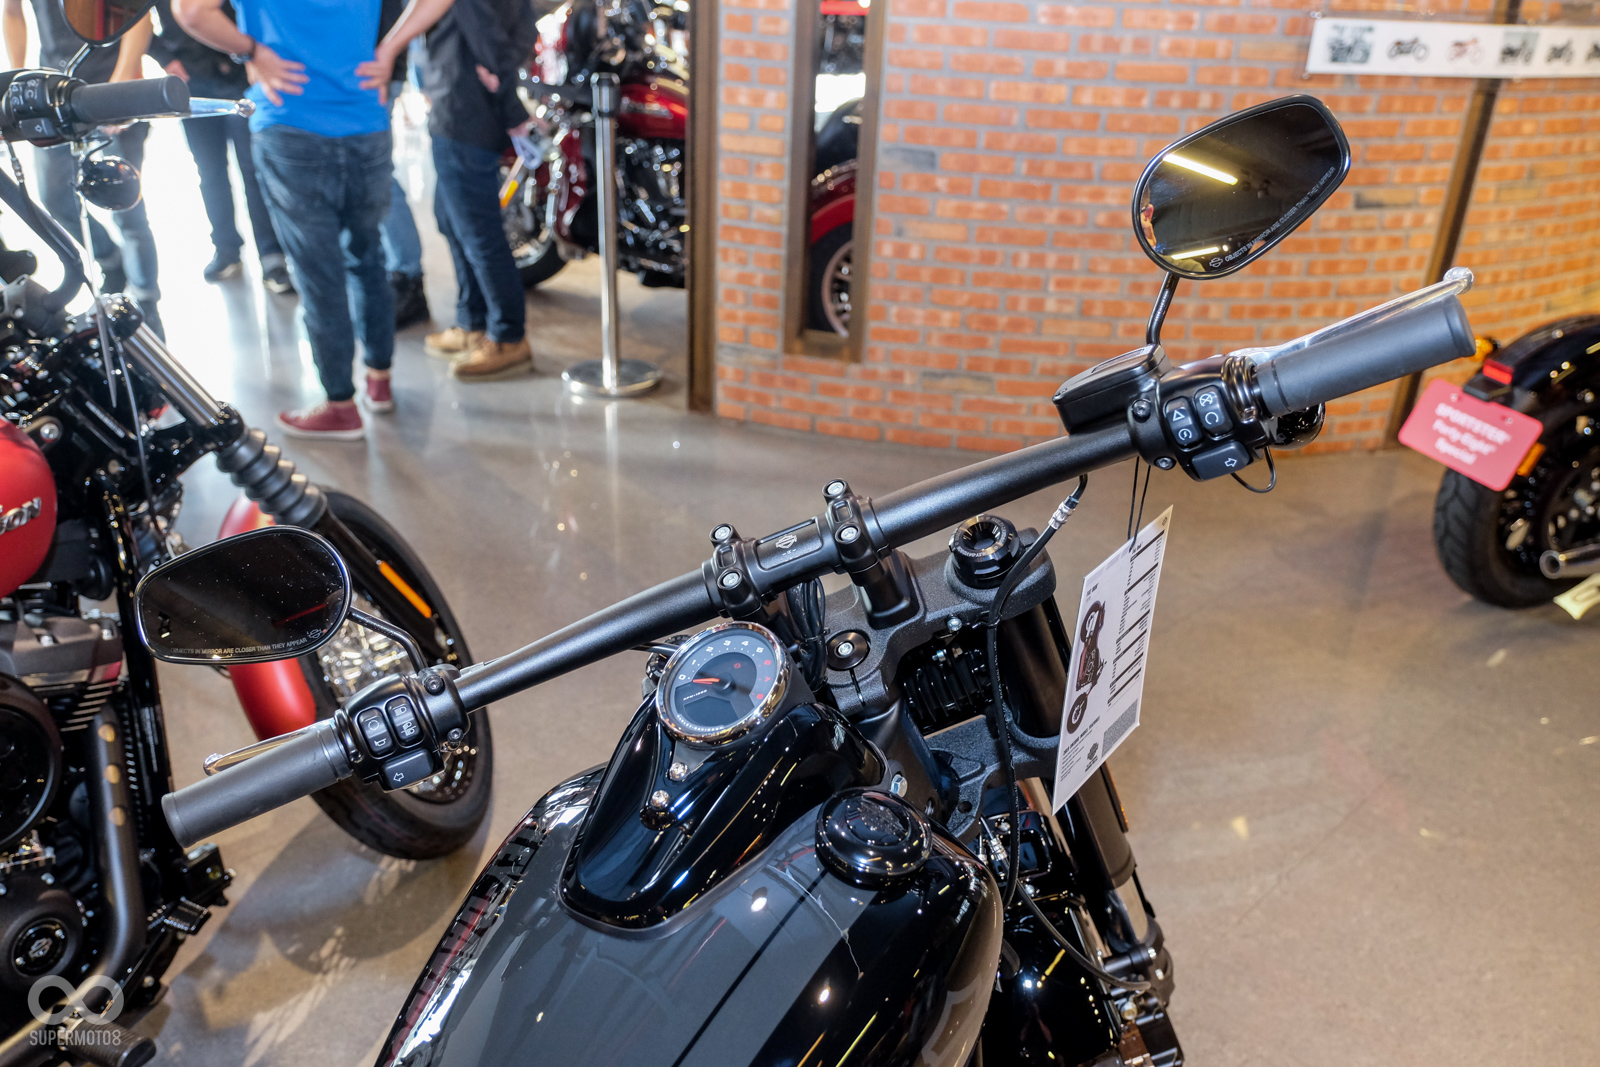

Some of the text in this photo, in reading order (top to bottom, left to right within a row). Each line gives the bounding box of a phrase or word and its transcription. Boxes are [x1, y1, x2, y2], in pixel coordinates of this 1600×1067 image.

[1225, 247, 1249, 262] OBJECTS
[1270, 221, 1281, 232] ARE
[1296, 195, 1310, 209] THAN
[1307, 185, 1320, 197] THEY
[1319, 166, 1336, 186] APPEAR
[257, 644, 271, 652] THAN
[286, 637, 308, 648] APPEAR
